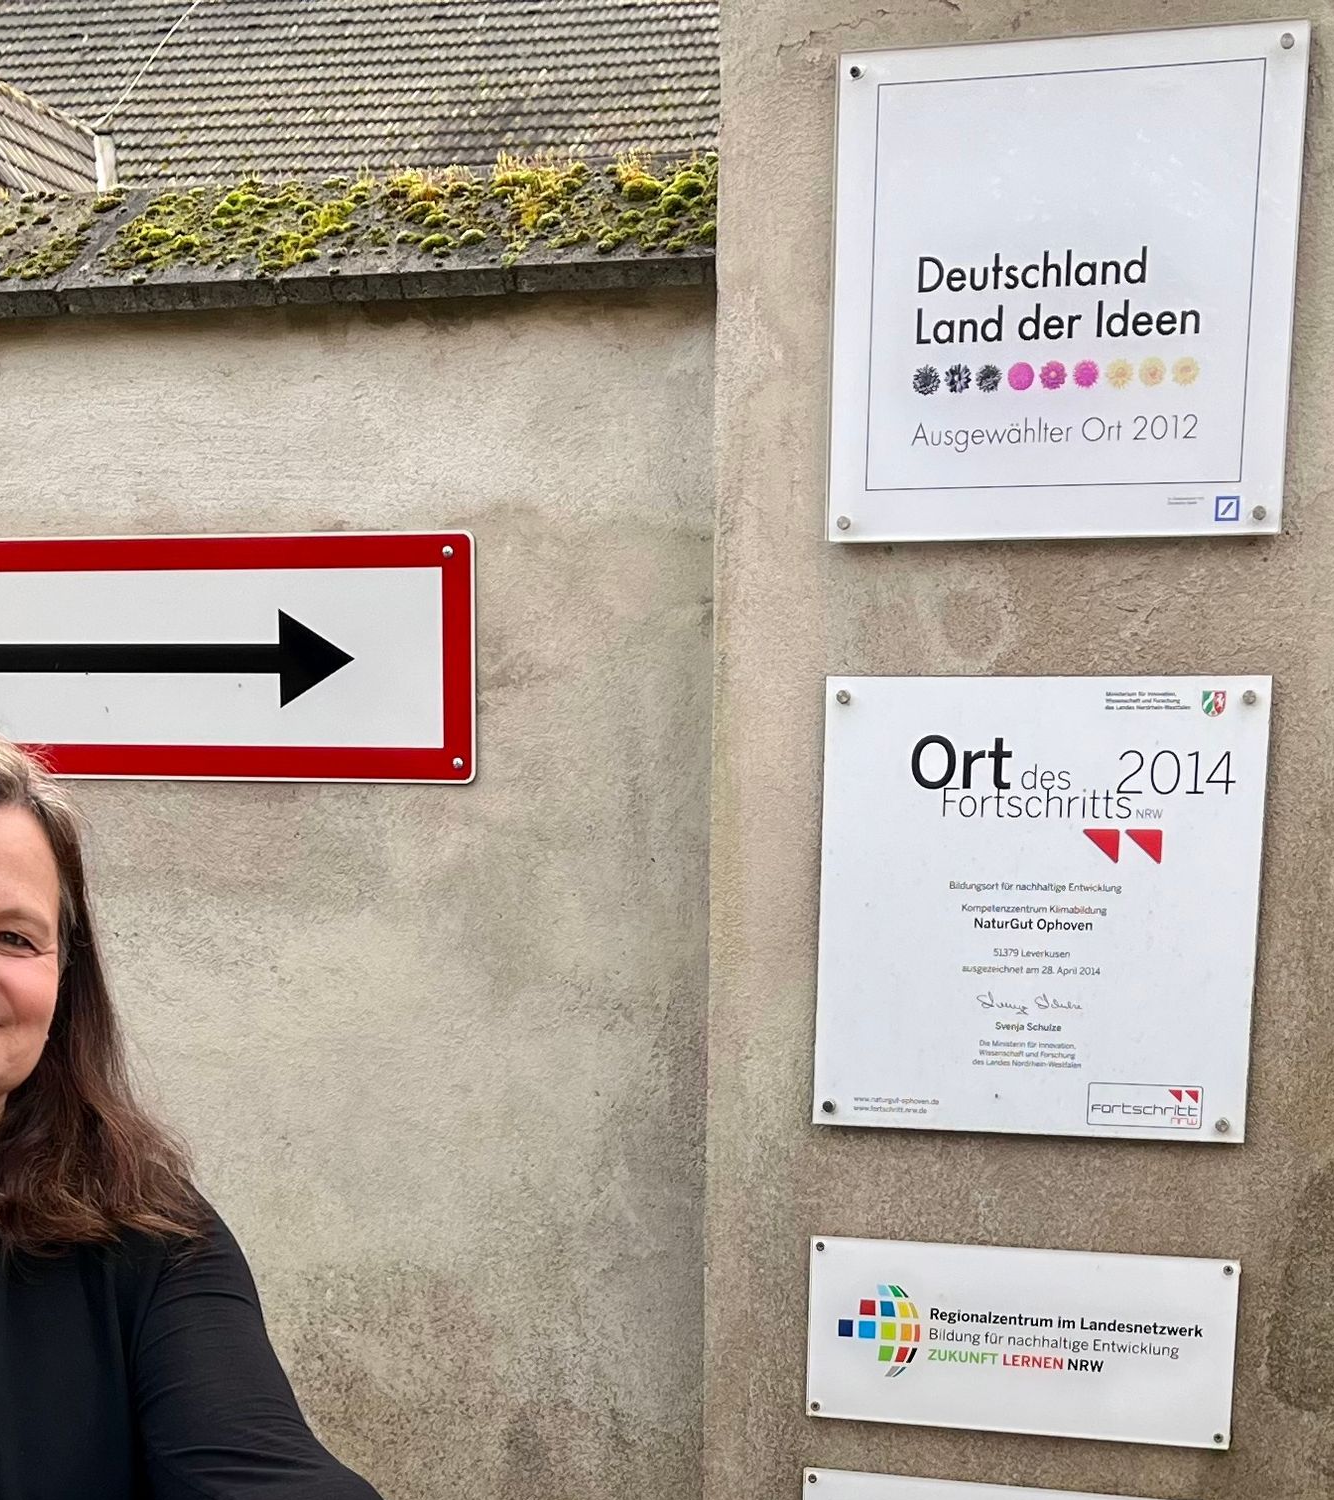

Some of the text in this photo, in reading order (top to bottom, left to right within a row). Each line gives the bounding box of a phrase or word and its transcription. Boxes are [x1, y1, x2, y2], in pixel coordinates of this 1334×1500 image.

[918, 246, 1147, 292] Deutschland
[916, 300, 1200, 344] Land der Ideen
[911, 414, 1197, 452] Ausgewählter Ort 2012
[912, 735, 1071, 790] Ort des
[1117, 750, 1236, 795] 2014
[943, 787, 1162, 819] Fortschritts NRW
[949, 881, 1122, 894] Bildungsort für nachhaltige Entwicklung
[962, 904, 1107, 916] Kompetenzzentrum Klimabildung
[974, 918, 1093, 932] NaturGut Ophoven
[993, 948, 1070, 958] 51379 Leverkusen
[962, 965, 1023, 974] ausgezeichnet
[1042, 966, 1054, 974] 28.
[1057, 966, 1077, 976] April
[1080, 967, 1100, 975] 2014
[995, 1022, 1061, 1032] Svenja Schulze
[1041, 1051, 1075, 1060] Forschung
[930, 1308, 1203, 1338] Regionalzentrum im Landesnetzwerk
[929, 1328, 1180, 1359] Bildung für nachhaltige Entwicklung
[928, 1348, 1104, 1373] ZUKUNFT LERNEN NRW
